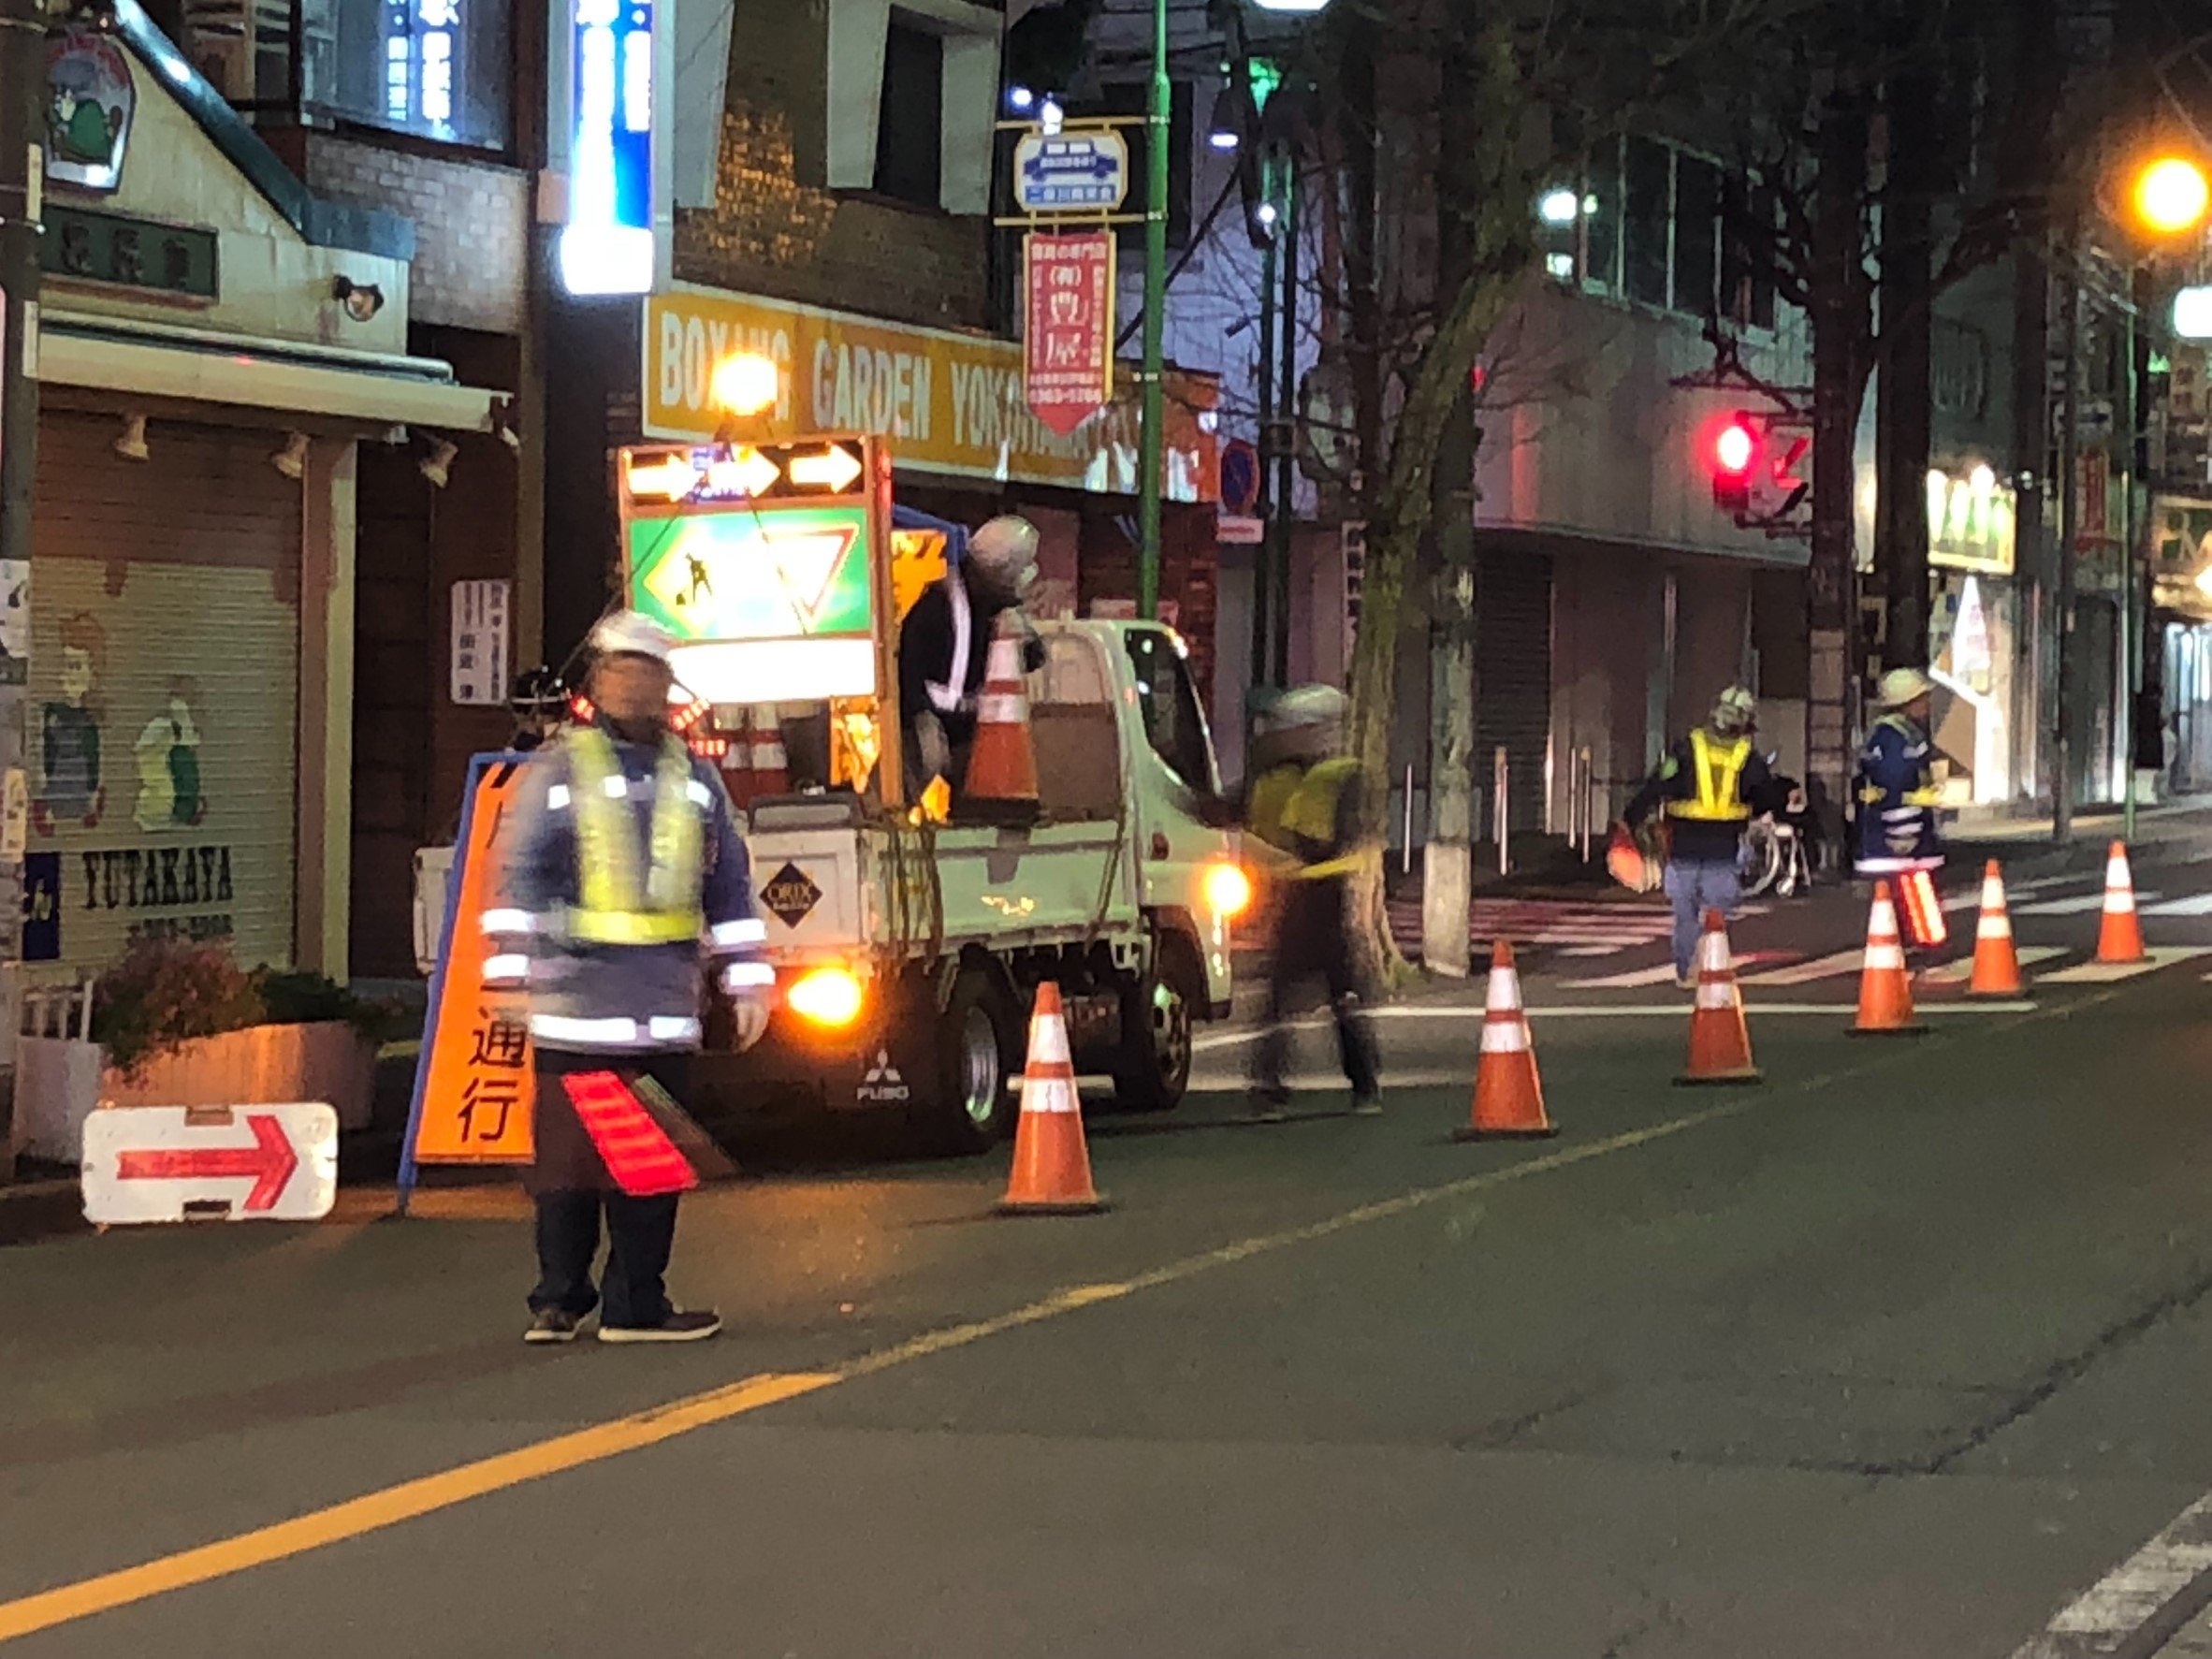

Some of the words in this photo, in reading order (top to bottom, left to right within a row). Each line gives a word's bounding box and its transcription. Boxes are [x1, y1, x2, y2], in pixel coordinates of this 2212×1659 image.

[813, 337, 932, 441] GARDEN
[82, 845, 234, 910] YUTAKAYA
[856, 1085, 910, 1100] FUSO
